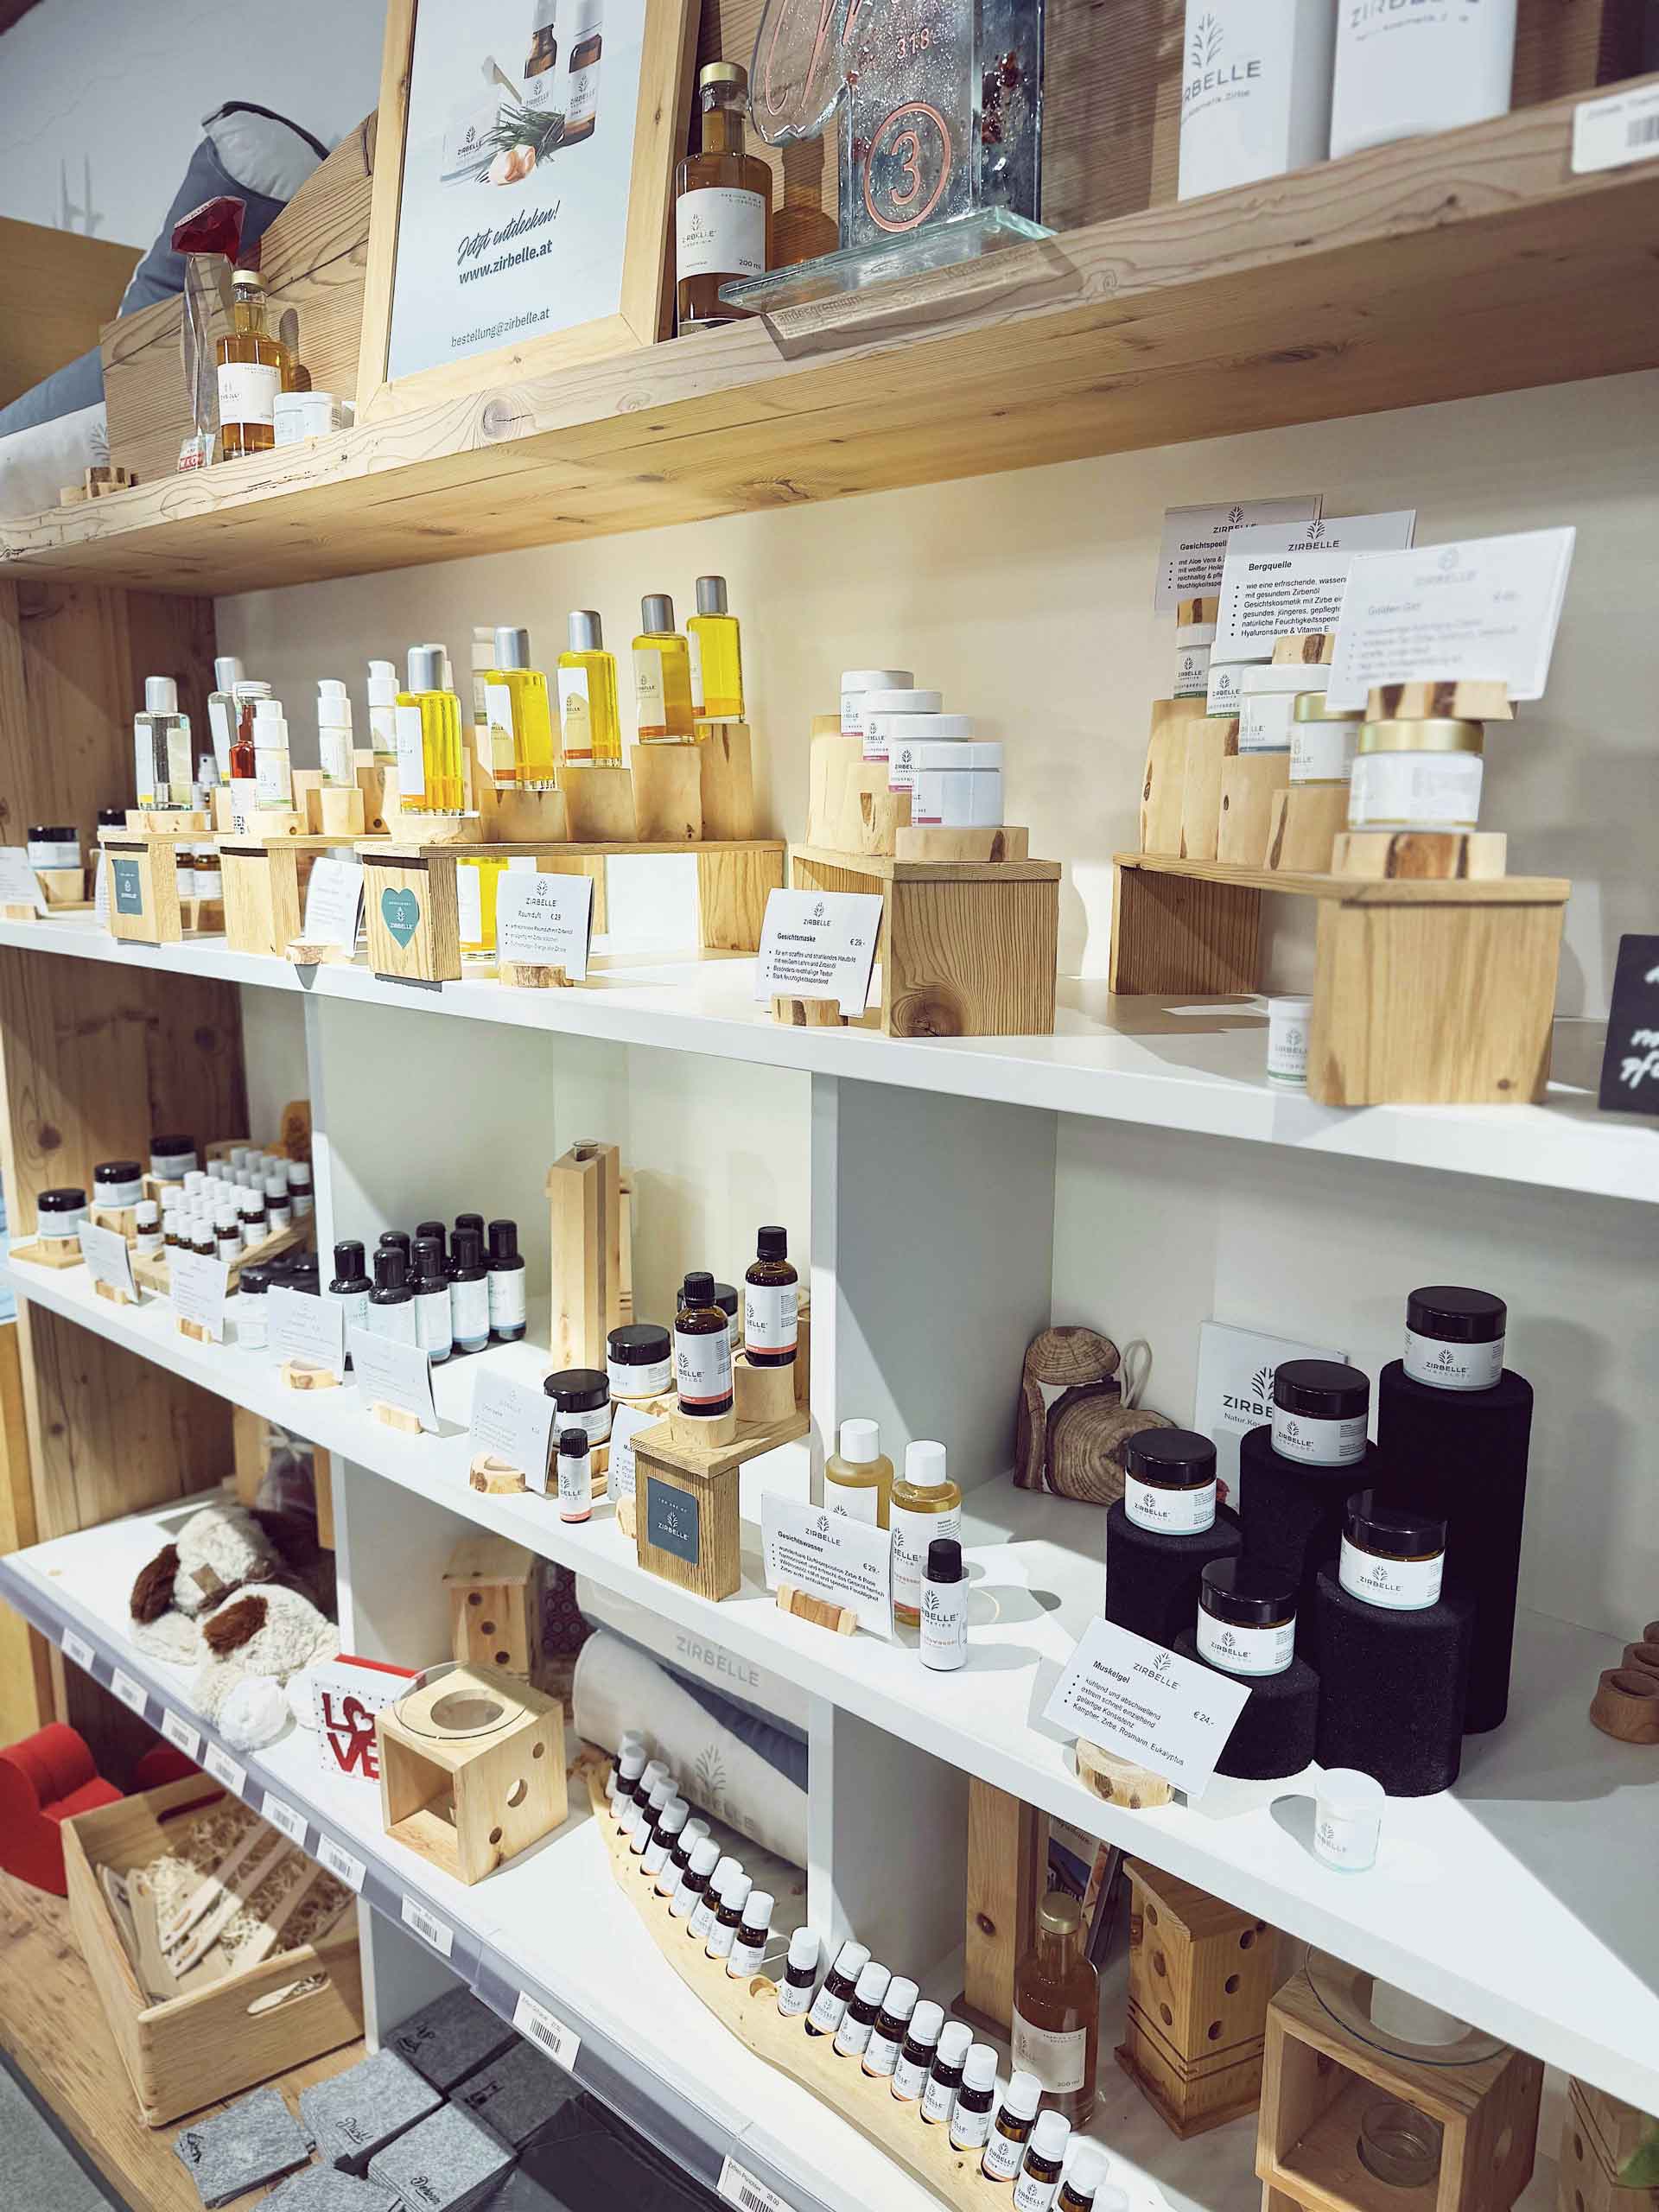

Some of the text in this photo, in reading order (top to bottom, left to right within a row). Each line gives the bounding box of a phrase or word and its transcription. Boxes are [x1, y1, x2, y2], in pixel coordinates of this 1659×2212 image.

[888, 130, 920, 205] 3
[457, 200, 560, 266] Jetzt entdecken!
[460, 239, 552, 283] www.zirbelle.at
[451, 307, 550, 346] bestellung@zirbelle.at
[1287, 540, 1341, 551] ZIRBELLE
[1249, 561, 1292, 571] Bergquelle
[1244, 600, 1301, 608] Gesichtskosmetik
[1256, 590, 1290, 600] gesundem
[1242, 619, 1274, 627] natürliche
[1241, 627, 1287, 638] Hyaluronsäure
[526, 898, 556, 906] ZIRBELLE
[777, 932, 816, 942] Gesichtsmaske
[1426, 1362, 1466, 1373] ZIRBELLE
[1278, 1432, 1313, 1446] ZIRBELLE
[1135, 1503, 1168, 1517] ZIRBELLE
[658, 1522, 688, 1540] ZIRBELLE
[805, 1528, 841, 1546] ZIRBELLE
[778, 1531, 823, 1553] Gesichtswasser
[1360, 1575, 1402, 1592] ZIRBELLE
[1211, 1642, 1249, 1657] ZIRBELLE
[676, 1637, 760, 1688] ZIRBELLE
[1091, 1659, 1130, 1685] Muskelgel
[1132, 1662, 1179, 1690] ZIRBELLE
[1080, 1686, 1156, 1728] extrem schnell einziehend
[1084, 1677, 1161, 1720] kühlend und abschwellend
[1075, 1694, 1135, 1728] gelartige Konsistenz
[1148, 1742, 1185, 1766] Eukalyptus
[988, 2148, 1015, 2166] ZIRBELLE
[1018, 2189, 1045, 2206] ZIRBELLE
